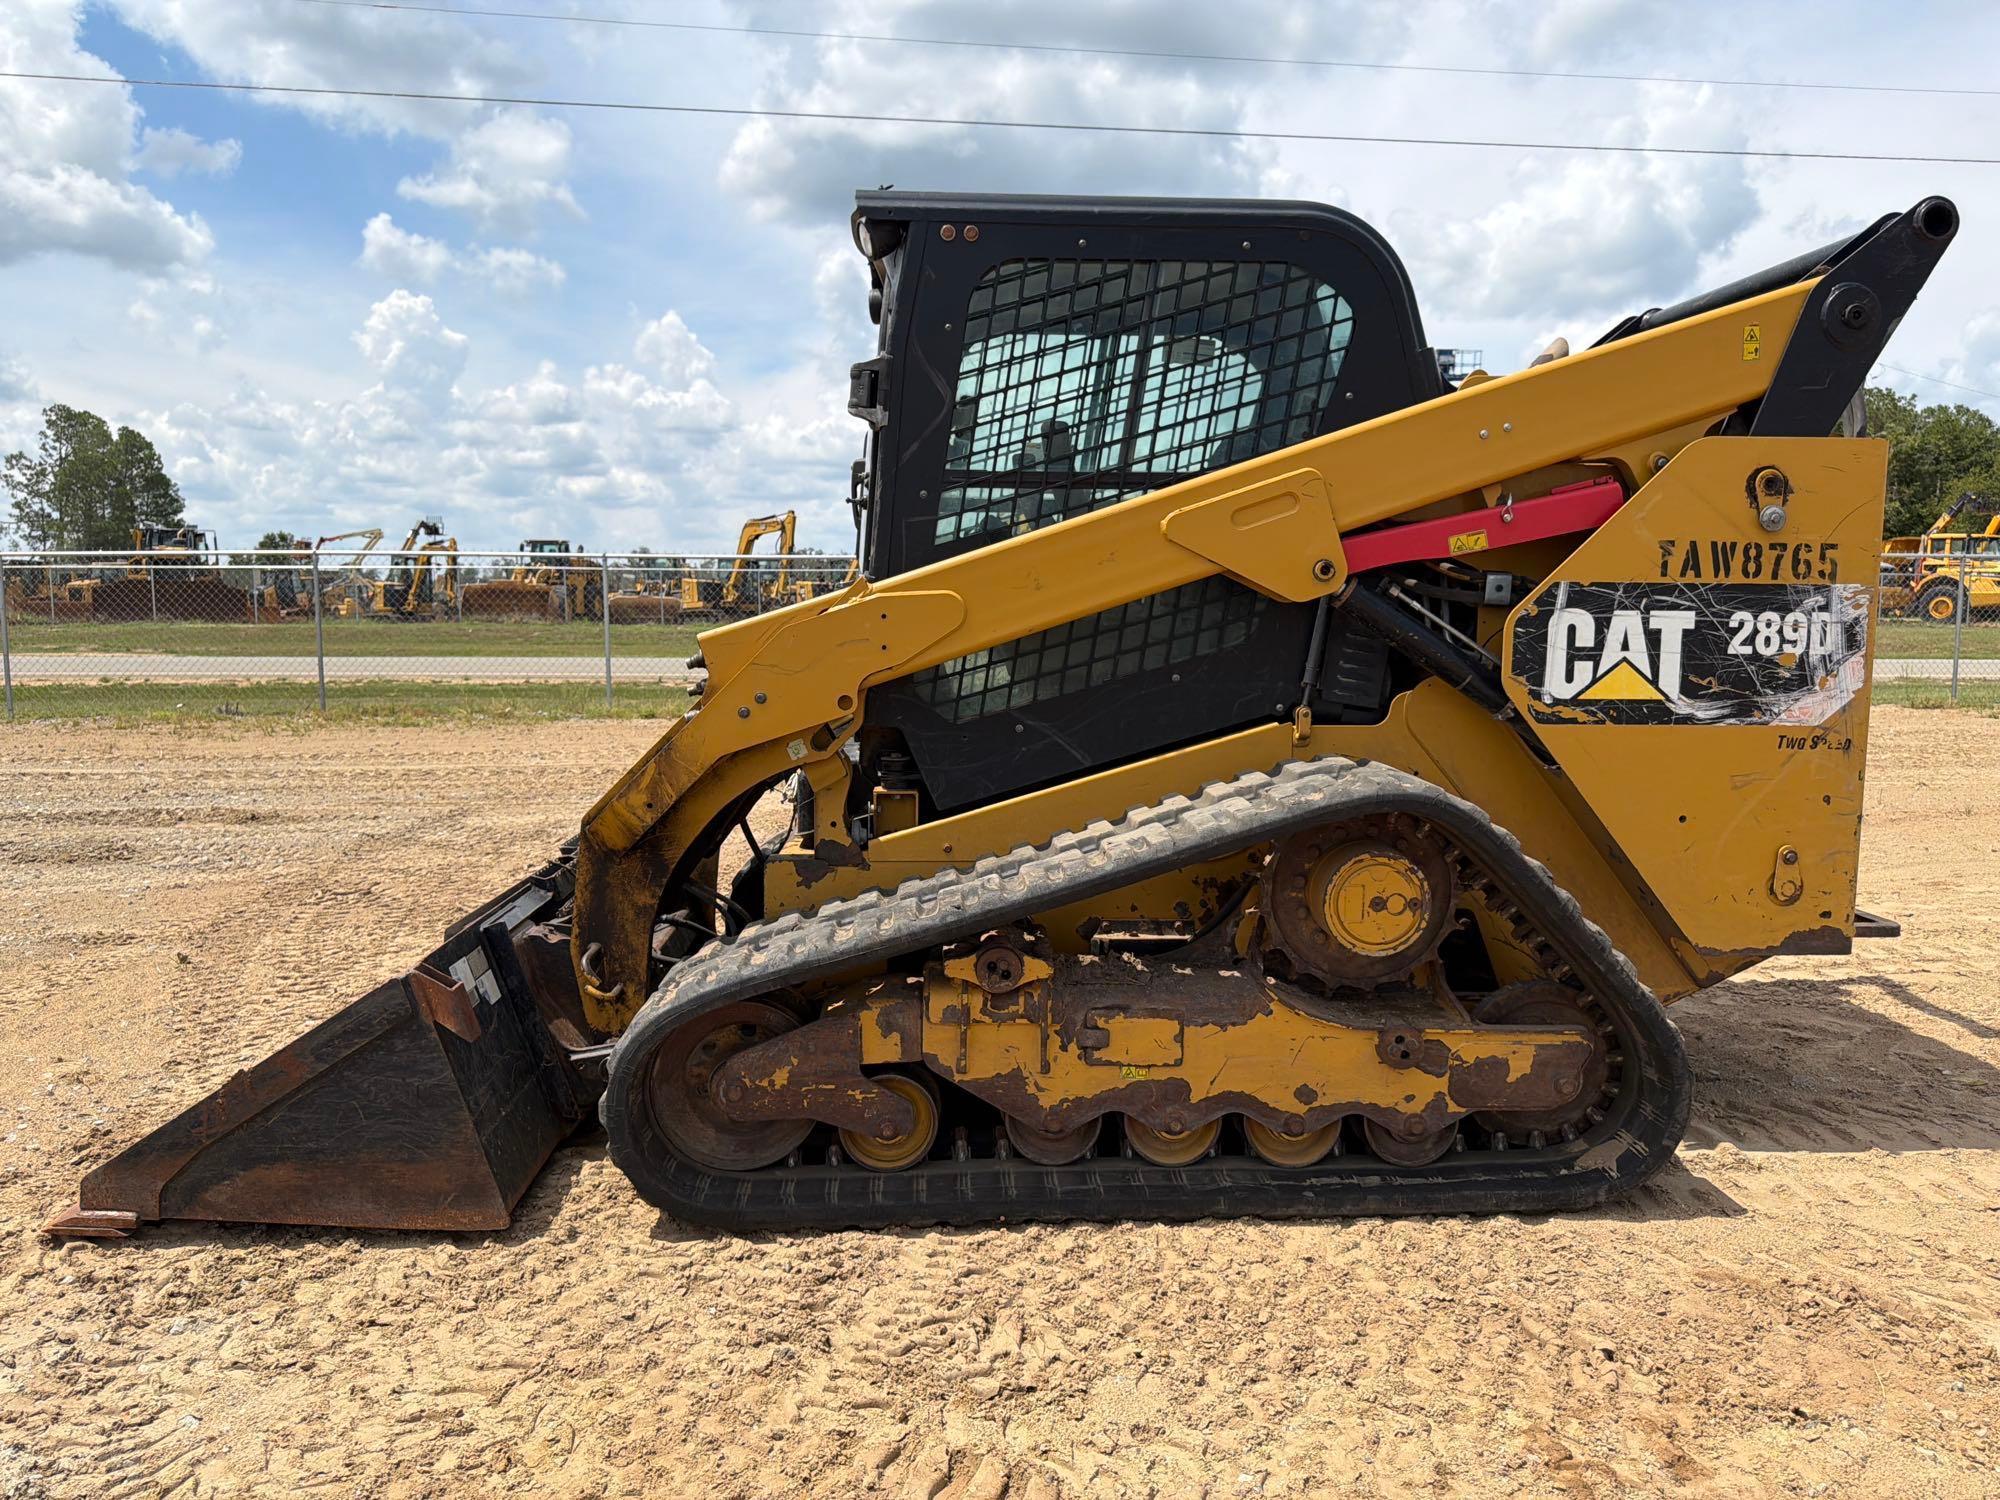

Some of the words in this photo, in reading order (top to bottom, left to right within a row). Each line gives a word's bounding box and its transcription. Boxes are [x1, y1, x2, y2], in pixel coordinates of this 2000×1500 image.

[1658, 540, 1838, 583] FAW8765
[1546, 608, 1696, 700] CAT
[1727, 611, 1833, 656] 289D
